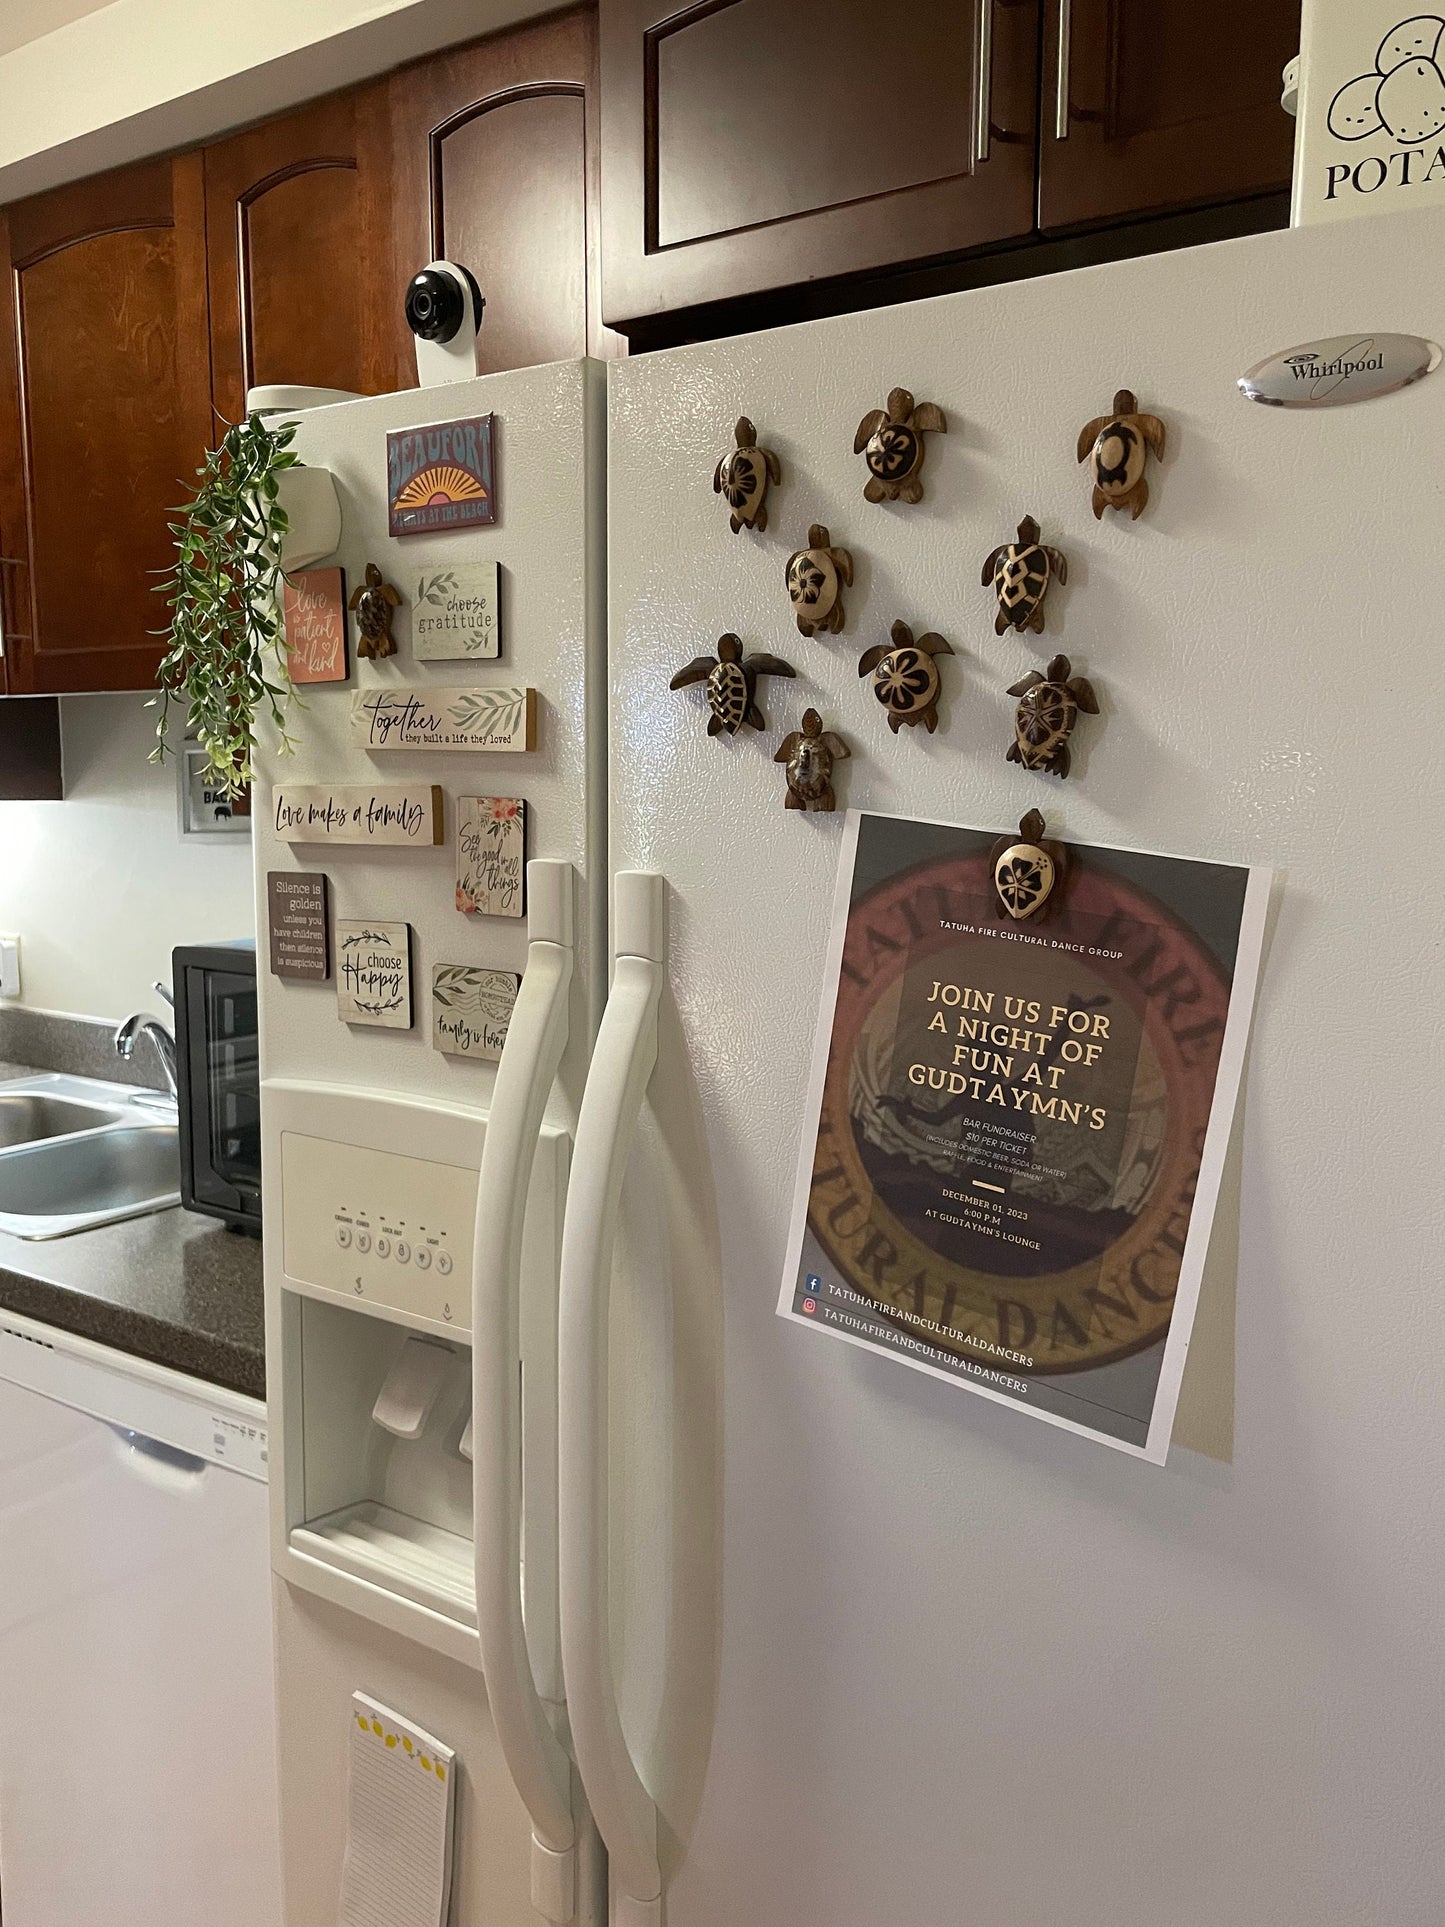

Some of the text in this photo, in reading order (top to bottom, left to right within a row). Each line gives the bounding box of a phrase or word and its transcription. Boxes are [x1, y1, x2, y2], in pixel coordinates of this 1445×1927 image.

[1291, 353, 1384, 380] Whirlpool
[390, 424, 490, 502] BEAUFORT
[429, 509, 439, 523] AT
[442, 505, 458, 522] THE
[460, 501, 489, 519] BEACH
[447, 594, 487, 613] choose
[419, 612, 492, 633] gratitude
[308, 637, 339, 673] kind
[405, 733, 421, 745] they
[423, 733, 442, 743] built
[452, 734, 468, 743] life
[471, 734, 487, 745] they
[490, 734, 512, 744] loved
[276, 795, 425, 836] Love makes a family
[459, 822, 481, 853] See
[469, 845, 480, 862] the
[476, 839, 503, 879] good
[505, 857, 519, 877] all
[276, 881, 321, 895] Silence is
[486, 863, 519, 908] things
[283, 914, 322, 926] unless you
[289, 898, 321, 911] golden
[273, 928, 322, 940] have children
[280, 943, 296, 952] then
[940, 920, 1123, 960] TATUHA FIRE CULTURAL DANCE GROUP
[278, 956, 323, 969] is suspicious
[341, 953, 403, 997] Happy
[368, 952, 401, 969] choose
[927, 981, 1111, 1039] JOIN US FOR
[437, 1015, 473, 1050] family
[473, 1031, 481, 1043] is
[927, 1011, 1103, 1067] A NIGHT OF
[952, 1044, 1065, 1090] FUN AT
[908, 1063, 1106, 1130] GUDTAYMN'S
[963, 1117, 1037, 1144] BAR FUNDRAISER
[965, 1132, 1027, 1155] $10 PER TICKET
[925, 1134, 958, 1149] (INCLUDES
[958, 1143, 992, 1158] DOMESTIC
[1011, 1157, 1030, 1168] SODA
[1031, 1163, 1042, 1171] OR
[1042, 1166, 1068, 1179] WATER)
[967, 1156, 986, 1167] FOOD
[993, 1164, 1044, 1182] ENTERTAINMENT
[942, 1188, 990, 1210] DECEMBER
[1007, 1207, 1028, 1221] 2023
[964, 1208, 982, 1219] 6:00
[925, 1209, 1042, 1251] AT GUDTAYMN'S LOUNGE
[828, 1284, 1034, 1368] TATUHAFIREANDCULTURALDANCERS
[824, 1308, 1028, 1393] TATUHAFIREANDCULTURALDANCERS
